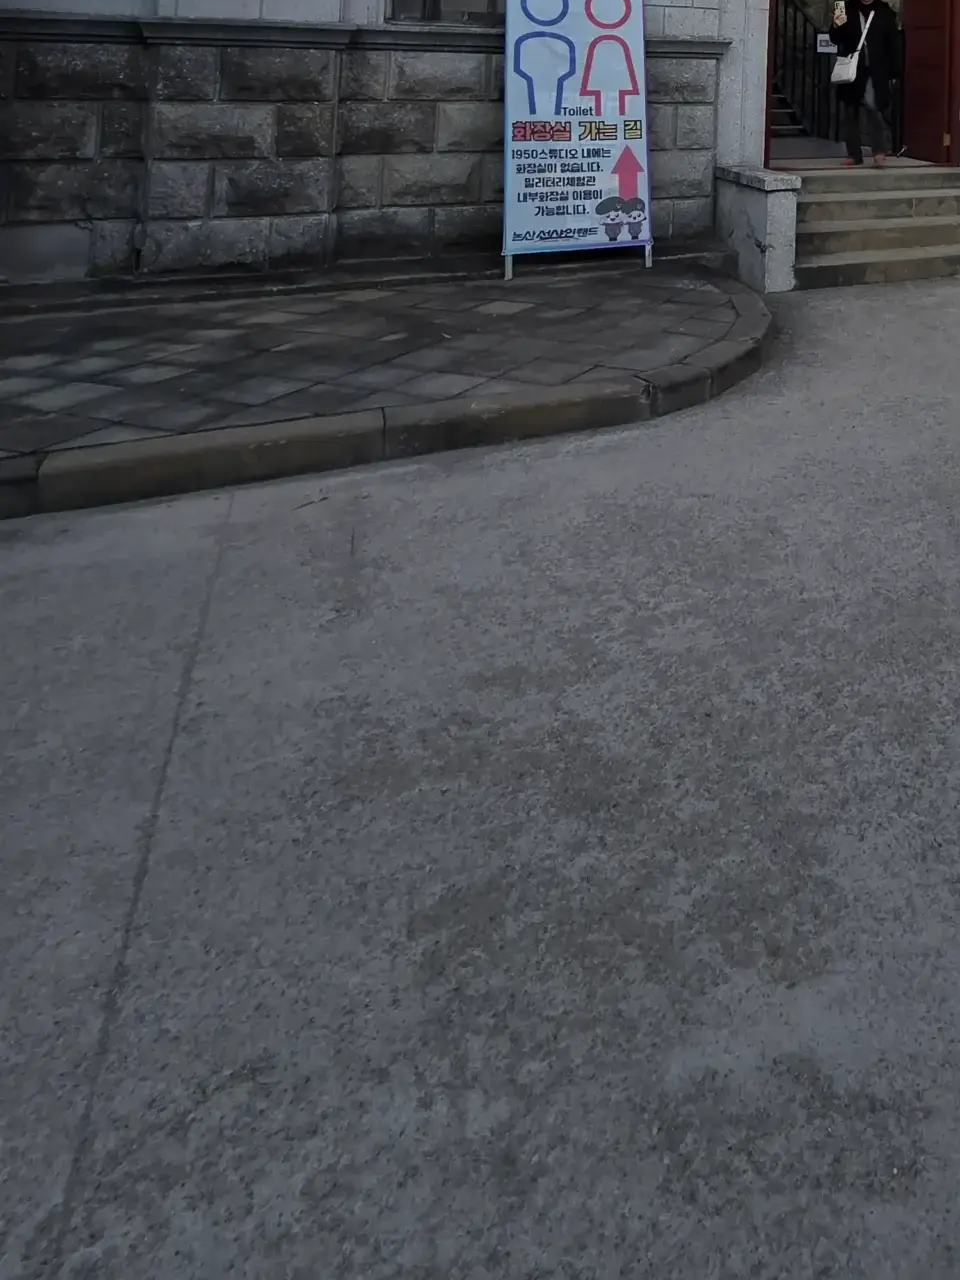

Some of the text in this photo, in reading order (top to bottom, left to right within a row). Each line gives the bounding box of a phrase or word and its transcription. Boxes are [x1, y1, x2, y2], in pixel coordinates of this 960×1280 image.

[562, 106, 594, 117] Toilet
[511, 119, 643, 141] 화장실 가는 길
[511, 147, 612, 160] 1950스튜디오 내에는
[515, 162, 604, 174] 화장실이 없습니다.
[524, 176, 596, 188] 밀리터리체험관
[517, 189, 603, 203] 내부화장실 이용이
[533, 204, 590, 217] 가능합니다.
